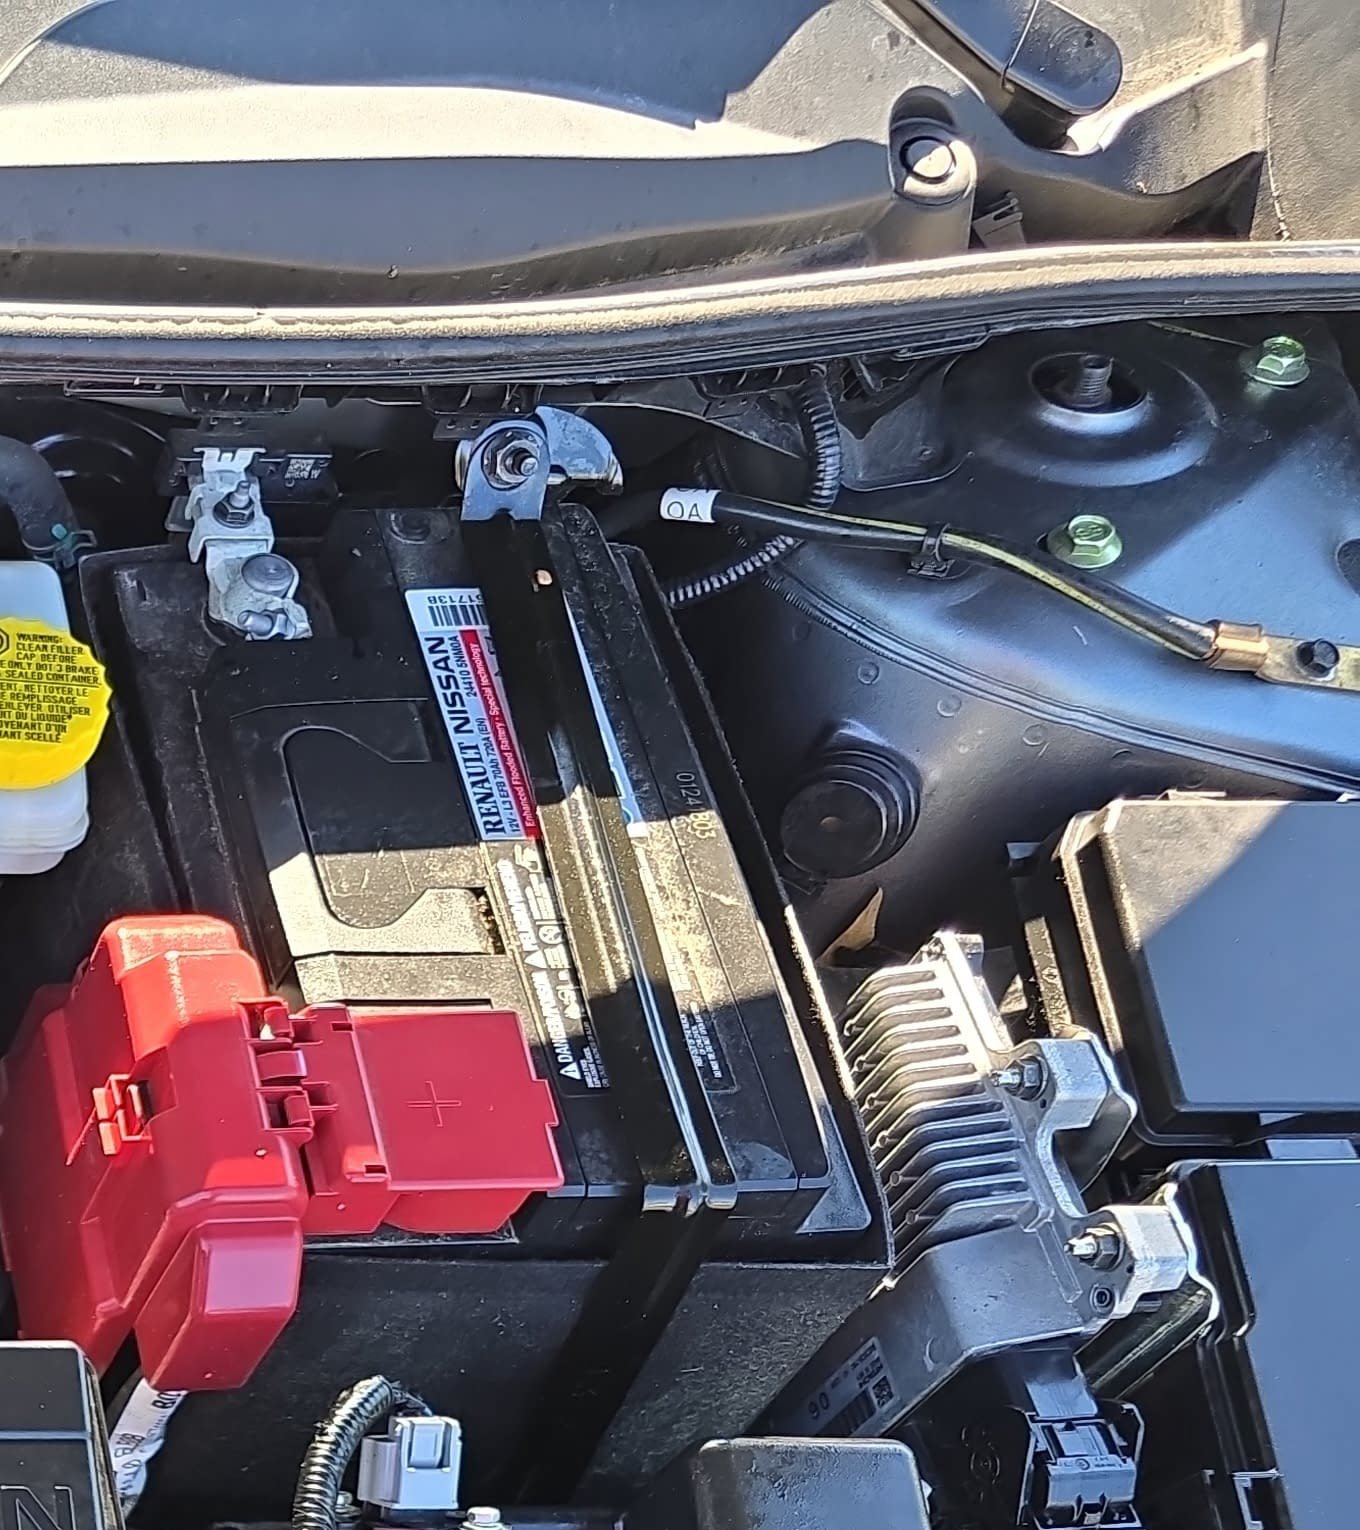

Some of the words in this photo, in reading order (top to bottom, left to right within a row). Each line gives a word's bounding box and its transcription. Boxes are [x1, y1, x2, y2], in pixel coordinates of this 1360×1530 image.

[16, 643, 48, 653] CLEAN
[50, 644, 83, 655] FILLER
[16, 652, 36, 662] CAP
[41, 653, 77, 664] BEFORE
[5, 669, 43, 680] SEALED
[8, 660, 32, 671] ONLY
[36, 662, 53, 672] DOT
[56, 663, 62, 672] 3
[65, 664, 98, 675] BRAKE
[470, 643, 491, 688] technology
[24, 683, 74, 697] NETTOYER
[76, 687, 88, 697] LE
[424, 636, 474, 735] NISSAN
[10, 692, 77, 705] REMPLISSAGE
[485, 690, 500, 717] Special
[15, 711, 27, 721] DU
[30, 712, 68, 723] LIQUIDE
[48, 704, 90, 716] UTILISER
[498, 722, 515, 751] Battery
[493, 757, 506, 780] 70Ah
[505, 751, 524, 785] Flooded
[458, 742, 507, 835] RENAULT
[499, 779, 511, 798] EFB
[516, 787, 536, 827] Enhanced
[506, 815, 520, 832] 12V
